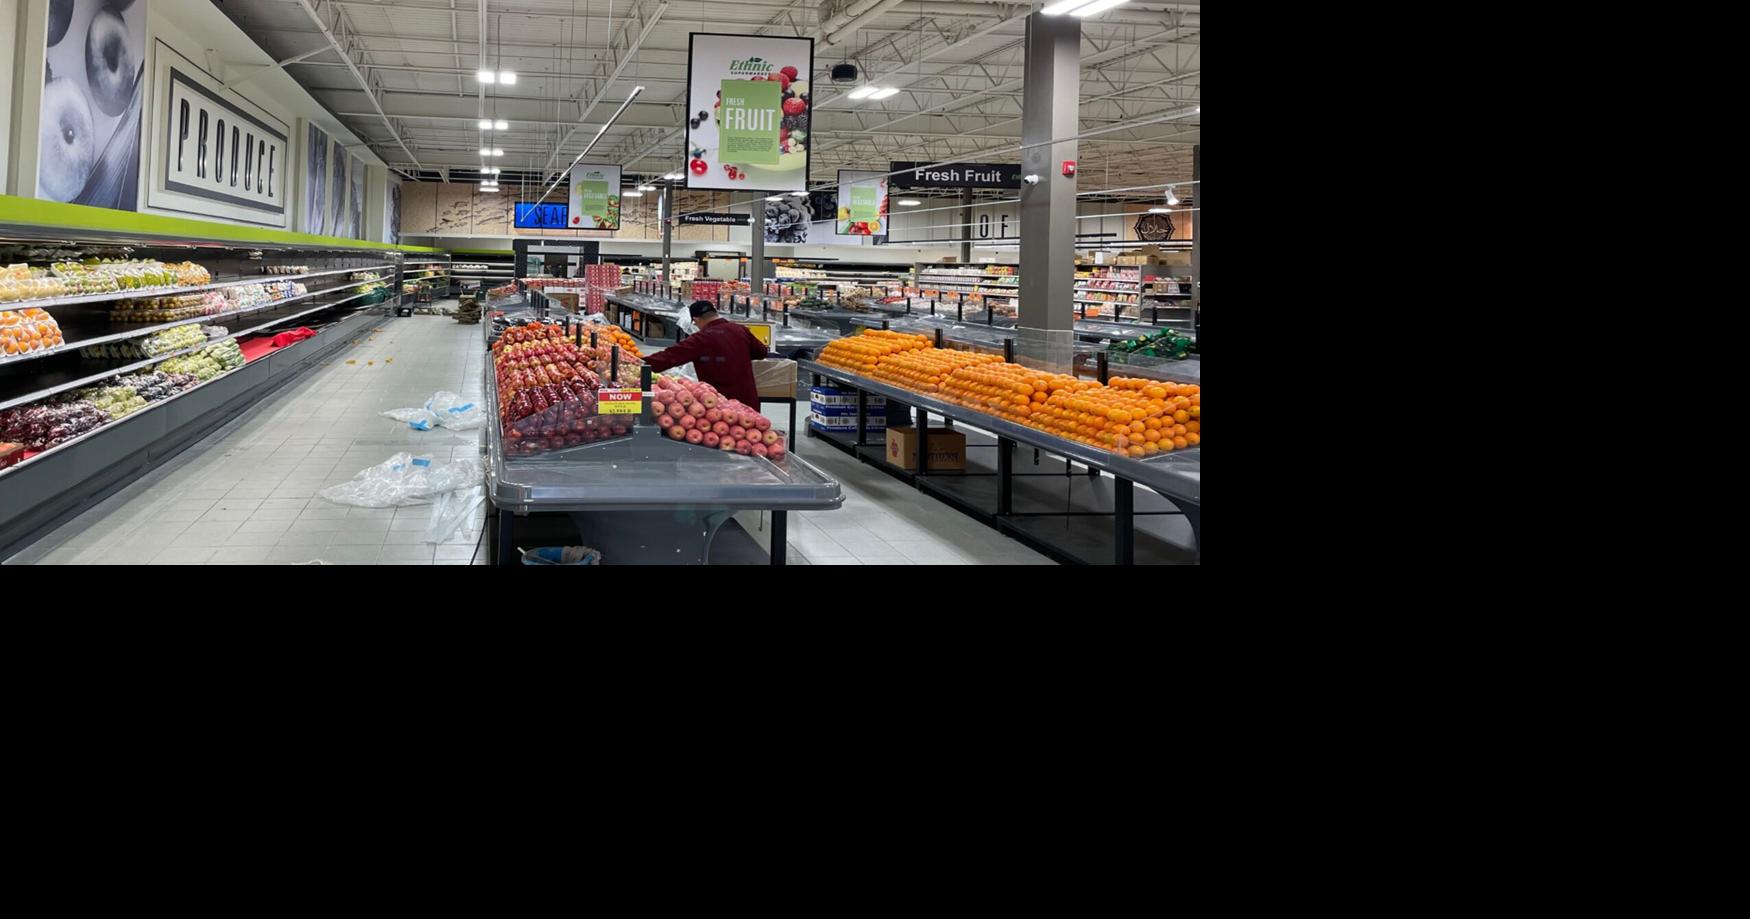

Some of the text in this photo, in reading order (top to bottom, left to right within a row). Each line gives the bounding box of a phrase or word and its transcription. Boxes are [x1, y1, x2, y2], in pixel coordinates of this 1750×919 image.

[729, 59, 774, 72] Ethnic
[725, 107, 776, 131] FRUIT
[177, 98, 276, 198] PRODUCE
[915, 168, 960, 181] Fresh
[965, 169, 1002, 182] Fruit
[704, 215, 736, 223] Vegetable
[609, 393, 633, 401] NOW
